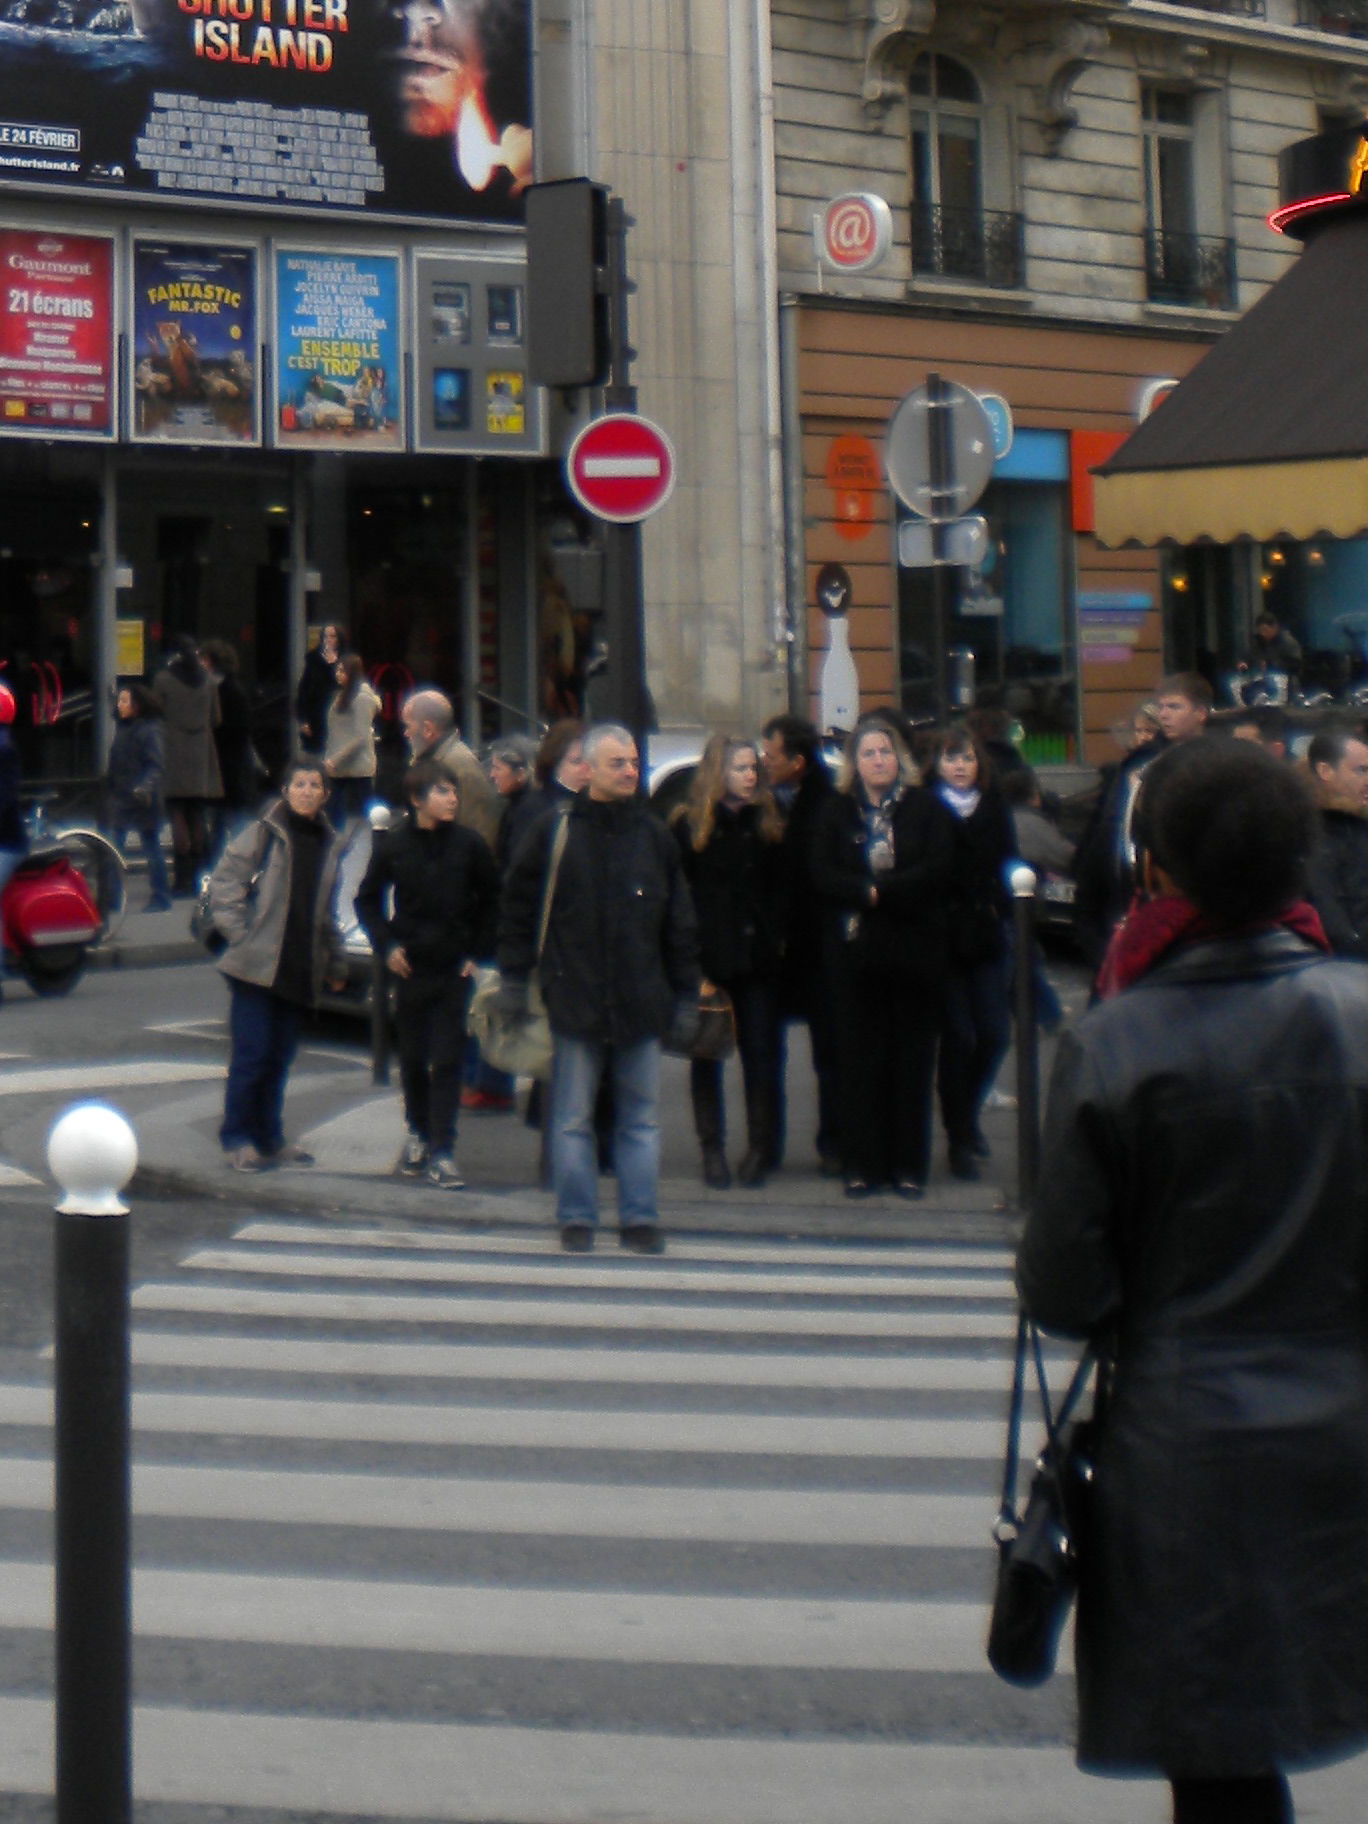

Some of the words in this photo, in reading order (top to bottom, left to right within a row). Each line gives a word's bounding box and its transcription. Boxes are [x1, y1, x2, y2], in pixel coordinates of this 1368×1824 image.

[194, 18, 333, 72] ISLAND
[12, 129, 27, 144] 24
[29, 129, 75, 148] FÉVRIER
[9, 289, 28, 313] 21
[33, 290, 93, 318] écrans
[147, 282, 241, 308] FANTASTIC
[302, 340, 380, 359] ENSEMBLE
[320, 358, 361, 376] TROP
